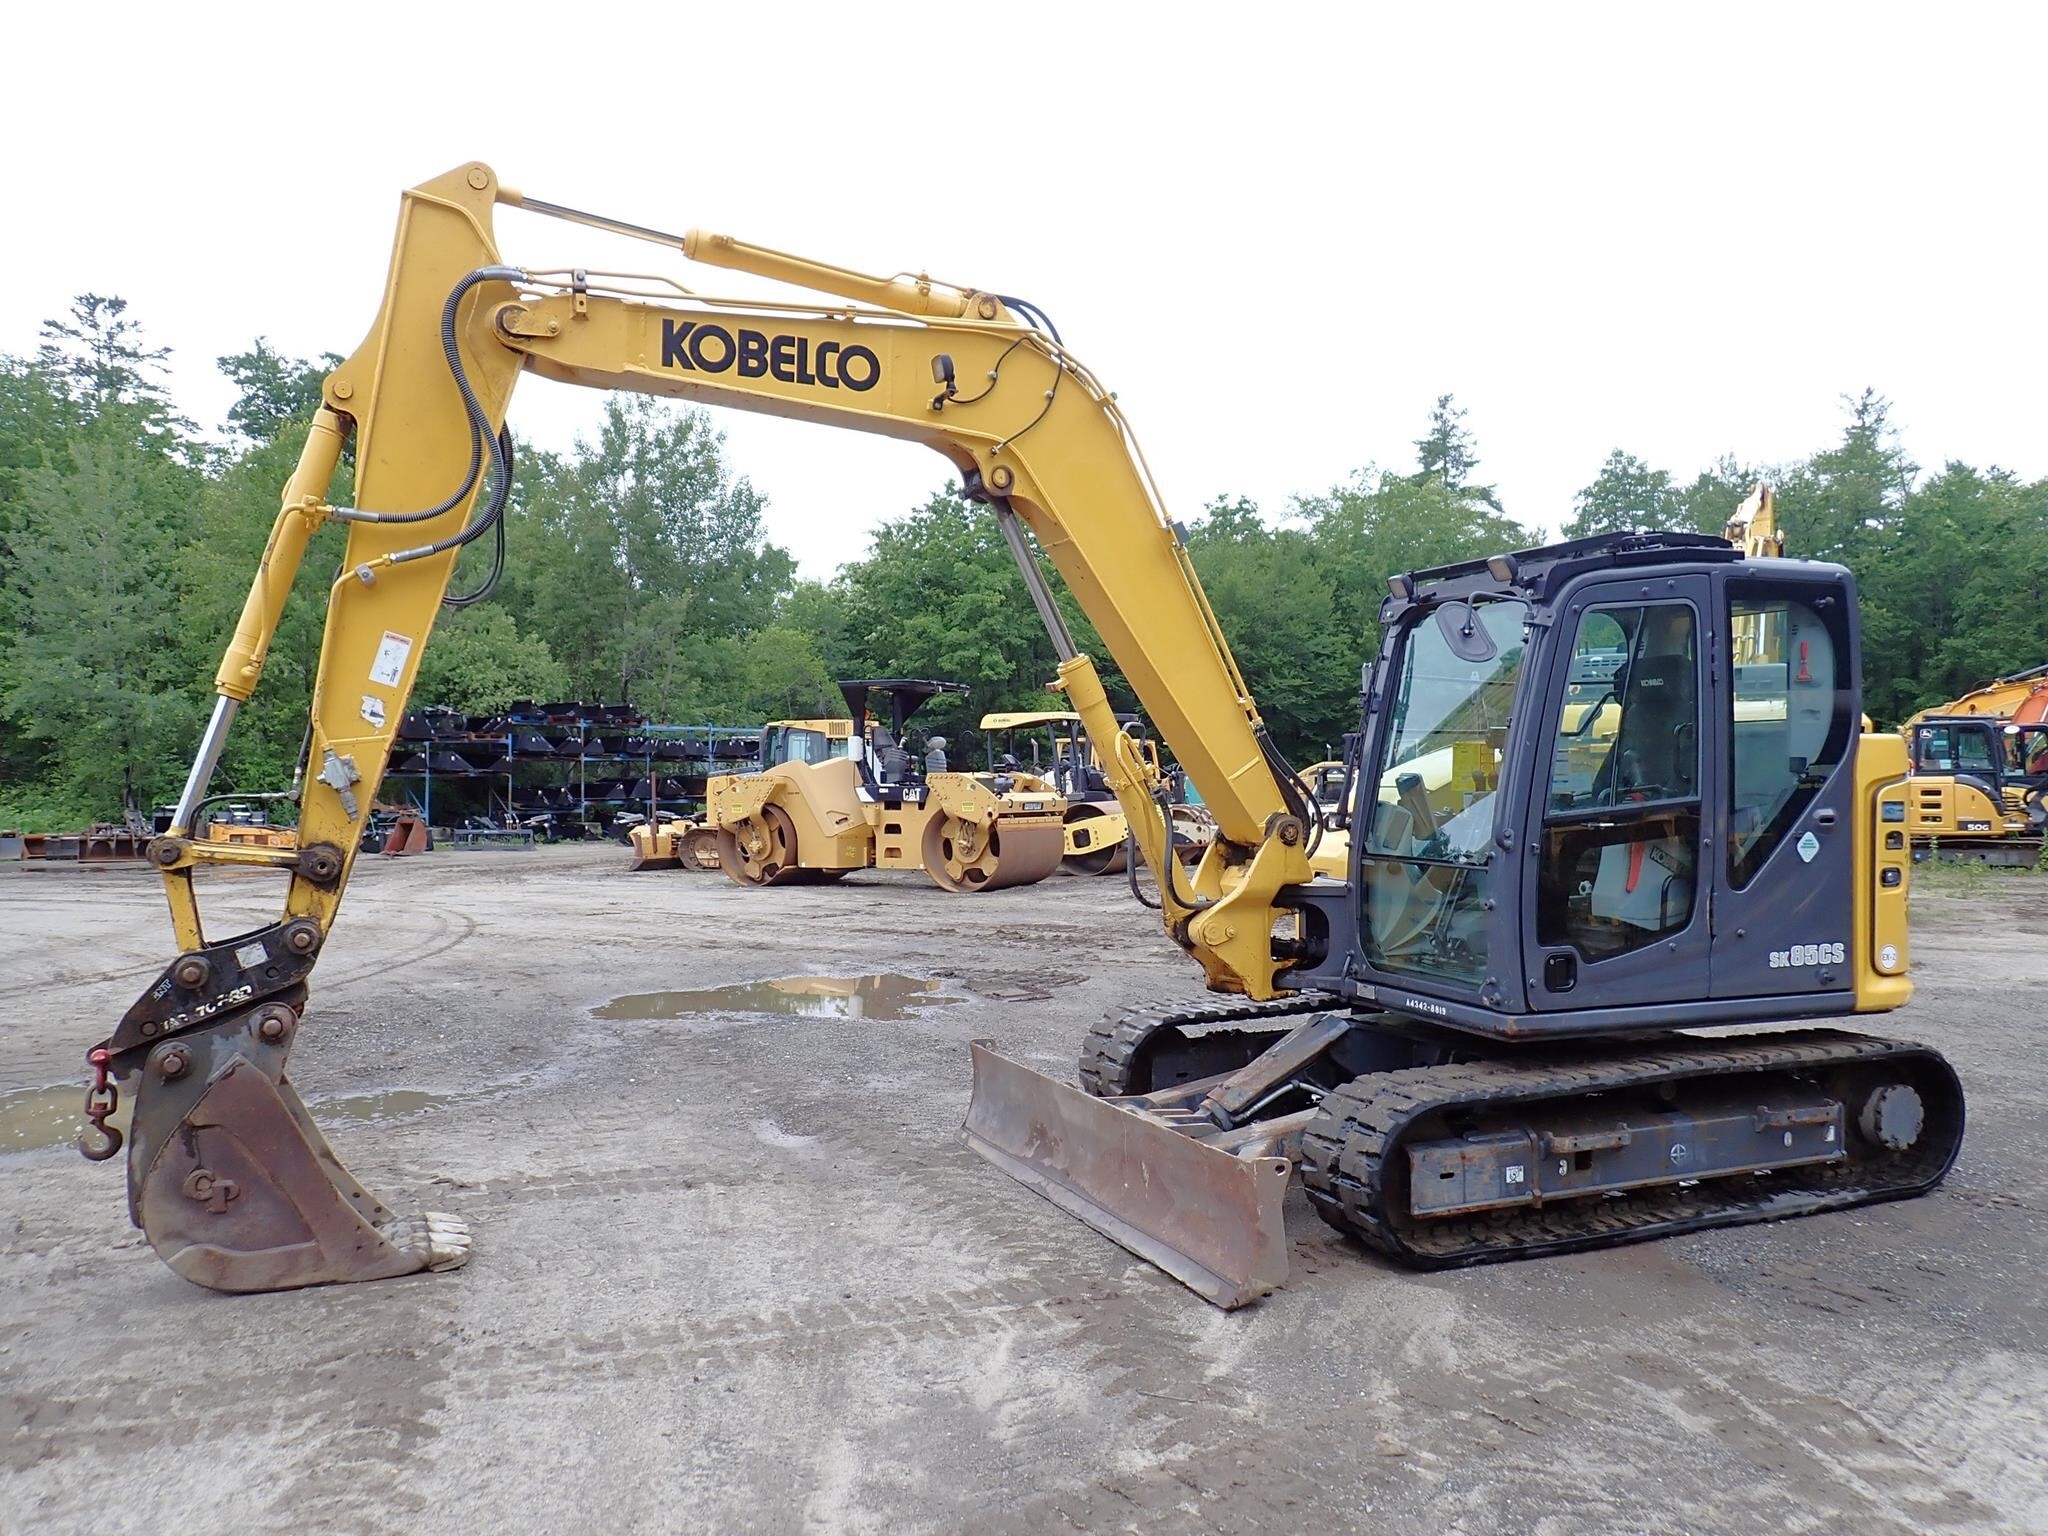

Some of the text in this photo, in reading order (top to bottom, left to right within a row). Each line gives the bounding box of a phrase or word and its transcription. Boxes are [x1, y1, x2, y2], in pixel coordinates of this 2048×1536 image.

[662, 317, 881, 392] KOBELCO
[902, 788, 921, 801] CAT
[1967, 823, 1990, 831] 50G
[1769, 942, 1845, 968] SK85CS
